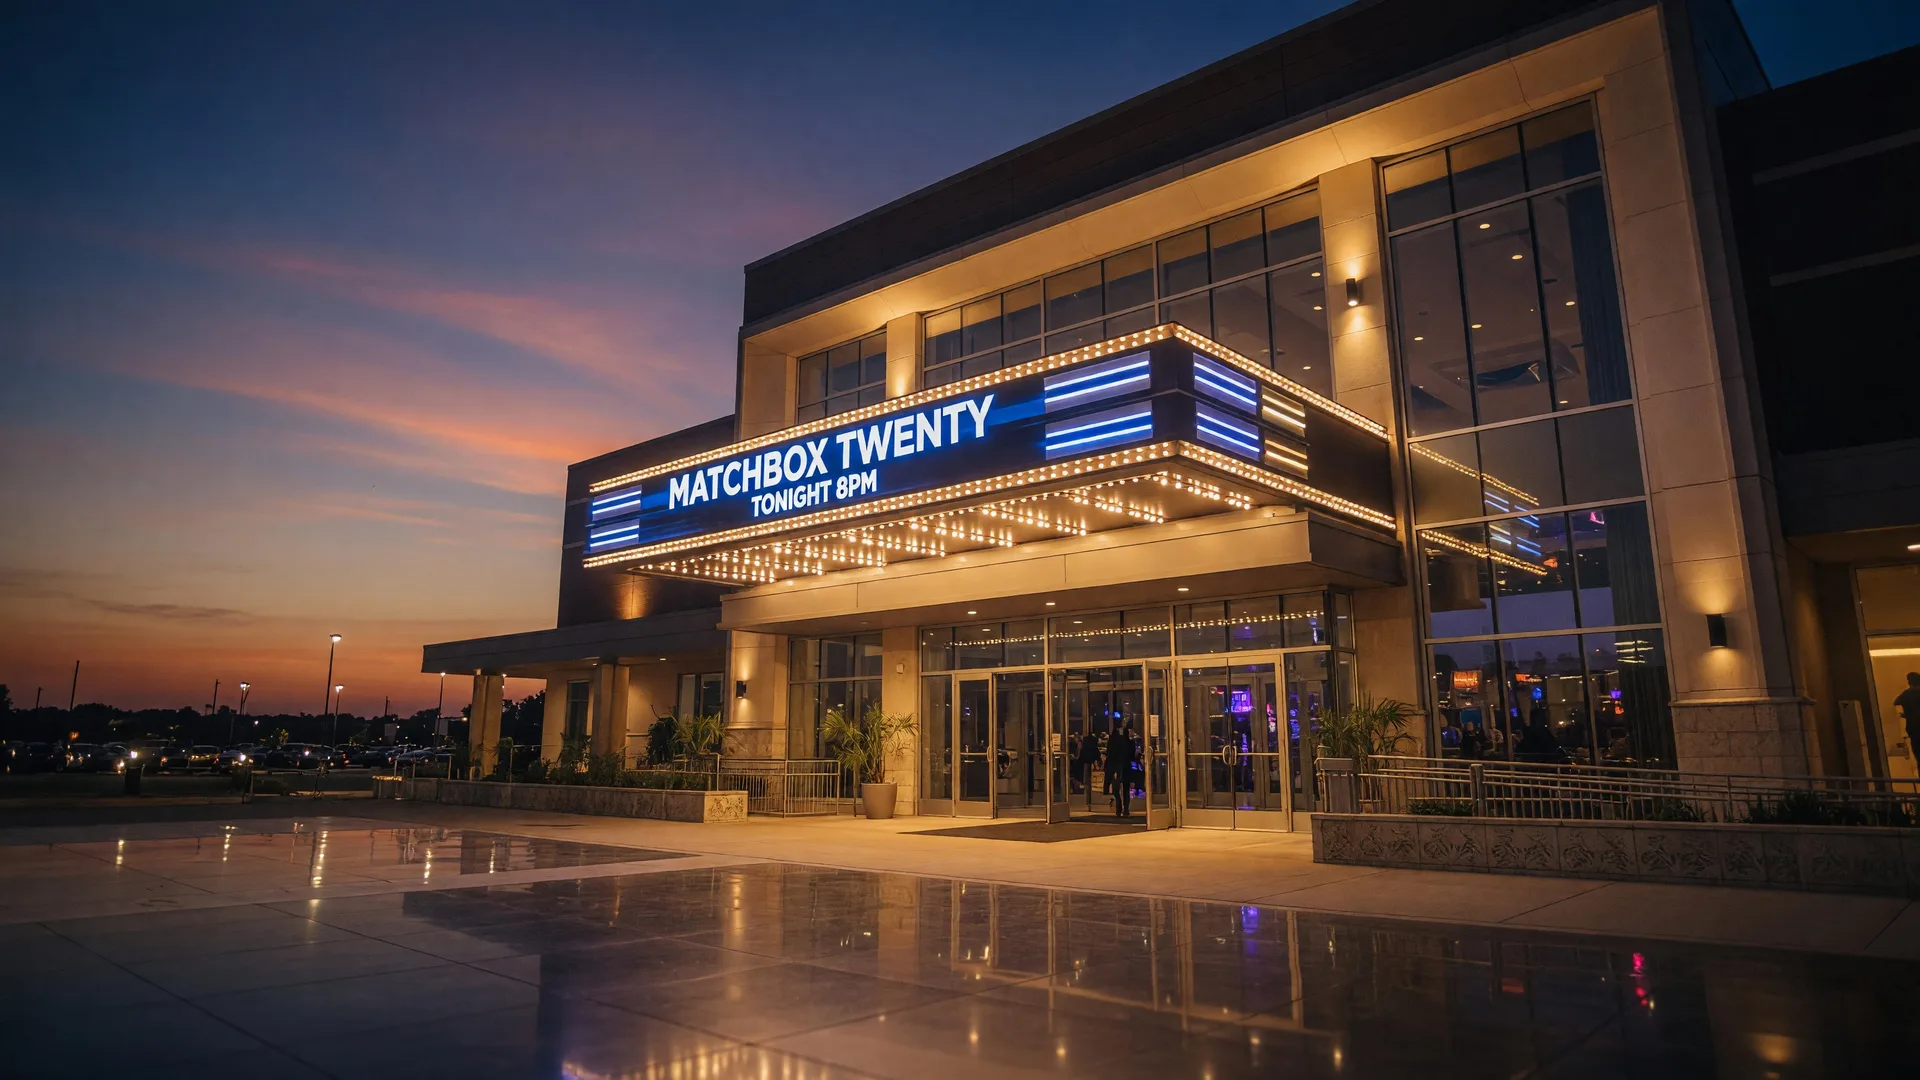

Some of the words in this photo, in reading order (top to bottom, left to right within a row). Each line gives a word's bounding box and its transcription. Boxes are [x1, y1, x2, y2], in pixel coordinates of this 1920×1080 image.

[668, 437, 829, 510] MATCHBOX
[836, 394, 995, 471] TWENTY
[751, 479, 833, 517] TONIGHT
[835, 468, 878, 500] 8PM
